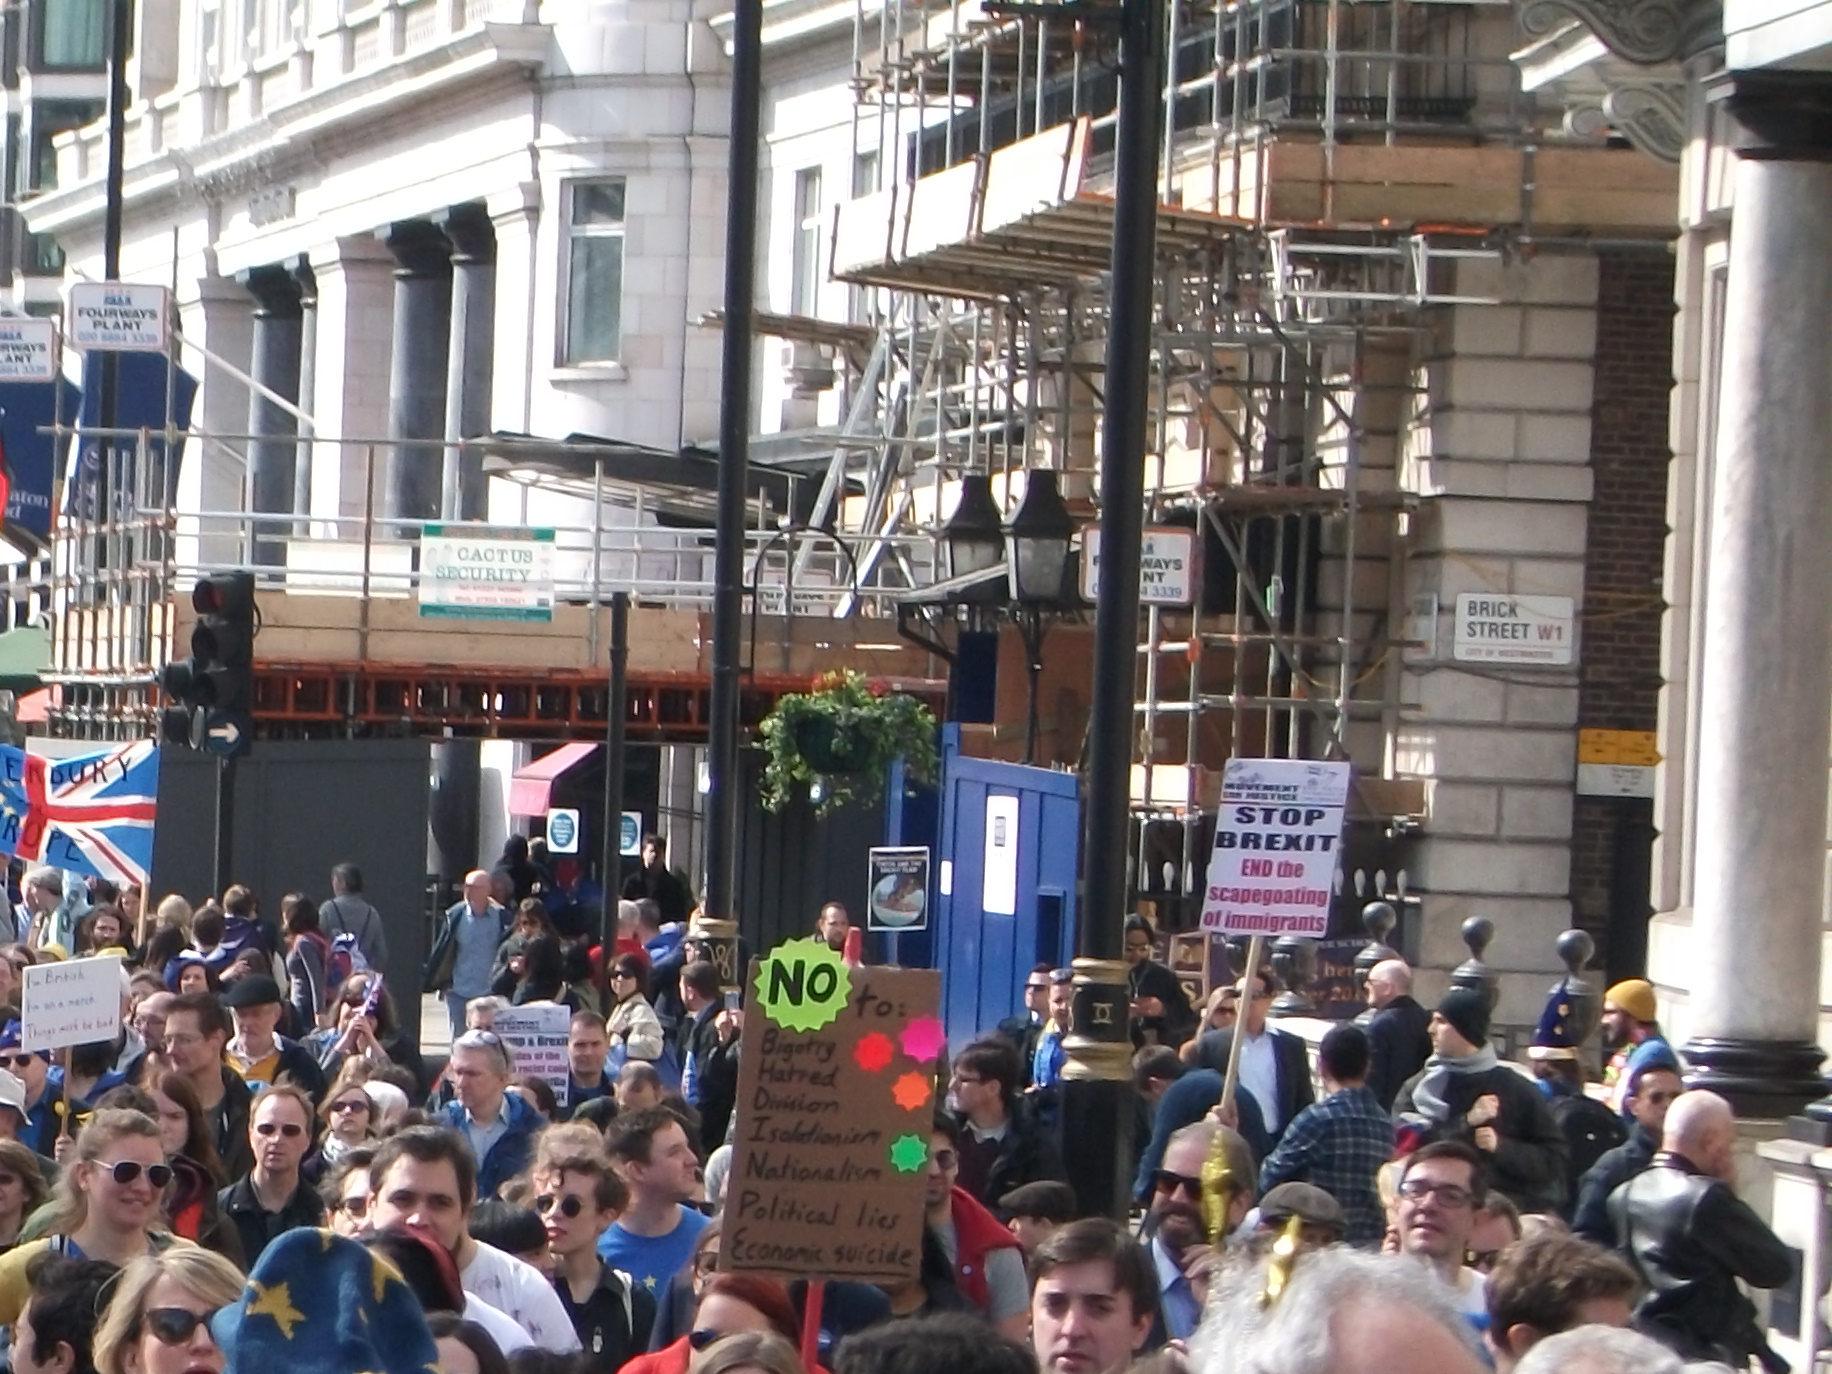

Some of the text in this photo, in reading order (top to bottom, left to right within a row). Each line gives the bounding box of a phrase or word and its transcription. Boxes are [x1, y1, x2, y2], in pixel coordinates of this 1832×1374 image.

[78, 308, 157, 319] FOURWAYS
[93, 321, 141, 331] PLANT
[457, 547, 533, 564] CACTUS
[435, 565, 531, 582] SECURITY
[1467, 600, 1518, 618] BRICK
[1467, 621, 1563, 641] STREET W1
[1235, 806, 1326, 826] STOP
[1215, 831, 1337, 852] BREXIT
[1241, 858, 1304, 878] END the
[1208, 886, 1327, 907] scapegoating
[1203, 910, 1325, 932] of immigrants
[768, 958, 838, 1006] NO
[761, 1028, 837, 1063] Bigotry
[757, 1058, 838, 1089] Hatred
[754, 1086, 839, 1113] Division
[748, 1117, 882, 1144] Isolationism
[746, 1152, 882, 1182] Nationalism
[738, 1191, 900, 1230] Political lies
[731, 1228, 912, 1267] Economic suicide
